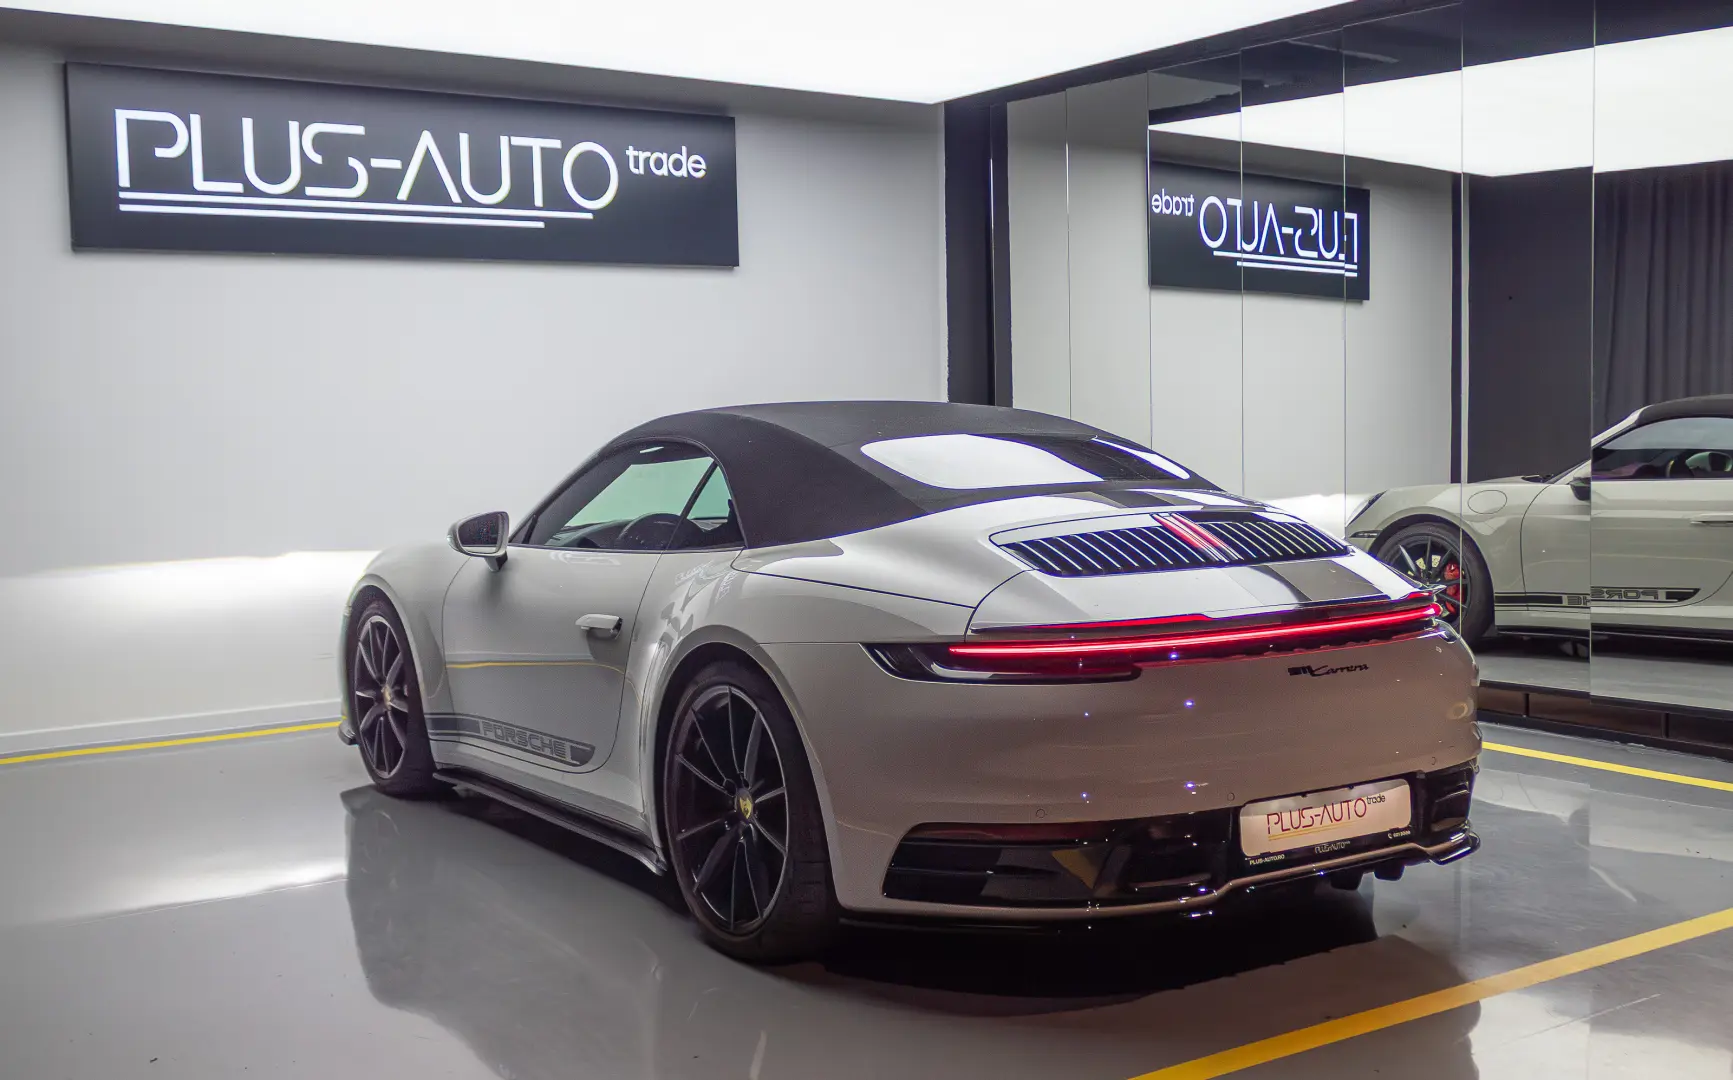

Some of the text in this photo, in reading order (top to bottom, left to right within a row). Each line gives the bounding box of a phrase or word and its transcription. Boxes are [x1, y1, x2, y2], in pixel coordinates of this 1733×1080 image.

[114, 108, 707, 211] PLUS-AUTO trade
[482, 721, 566, 759] PORSCHE
[1266, 795, 1386, 834] PLUS-AUTO trade
